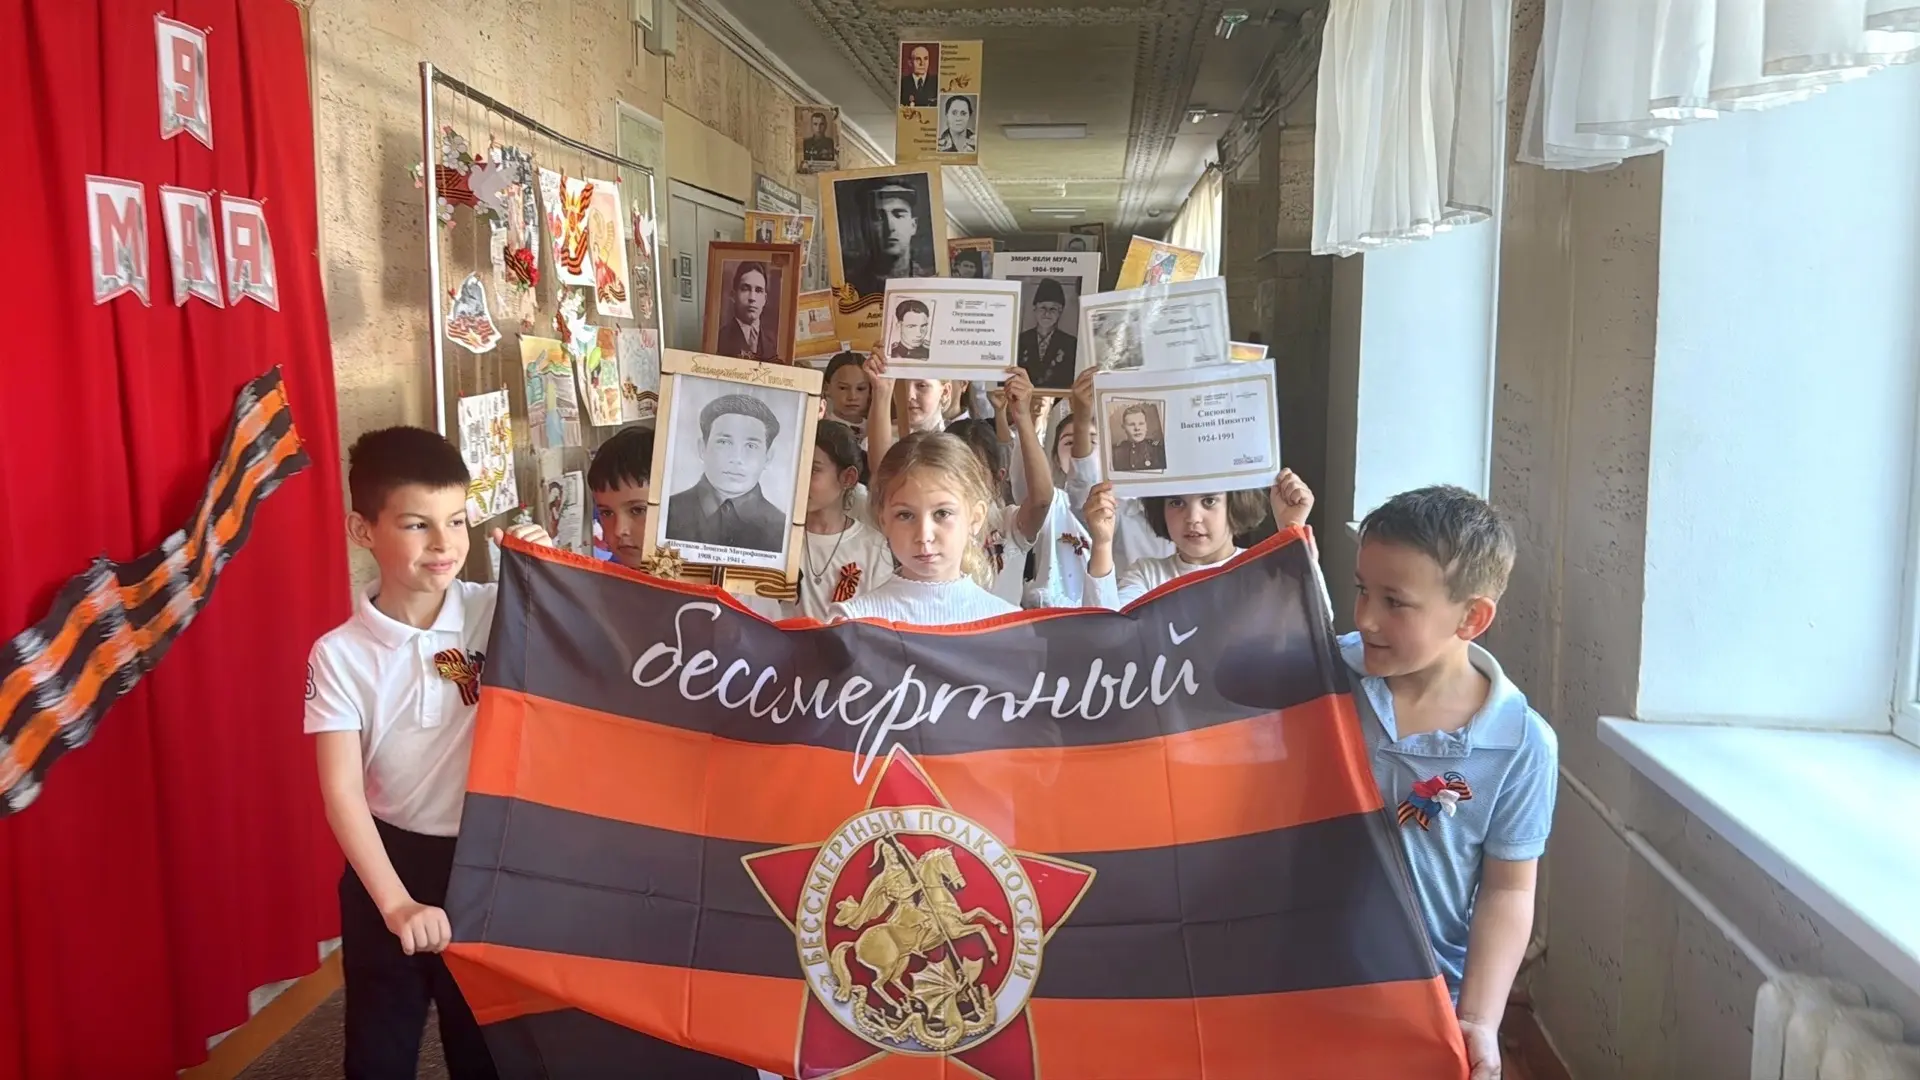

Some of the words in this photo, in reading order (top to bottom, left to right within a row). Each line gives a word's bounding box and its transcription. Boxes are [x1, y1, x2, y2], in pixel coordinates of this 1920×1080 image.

[172, 36, 197, 119] 9
[95, 192, 262, 285] МАЯ
[1052, 256, 1078, 264] МУРАД
[1180, 420, 1216, 429] Василий
[1218, 416, 1256, 425] Никитич
[1197, 432, 1235, 443] 1924-1991
[800, 809, 907, 967] БЕССМЕРТНЫЙ
[918, 810, 996, 859] ПОЛК
[992, 855, 1040, 981] РОССИИ
